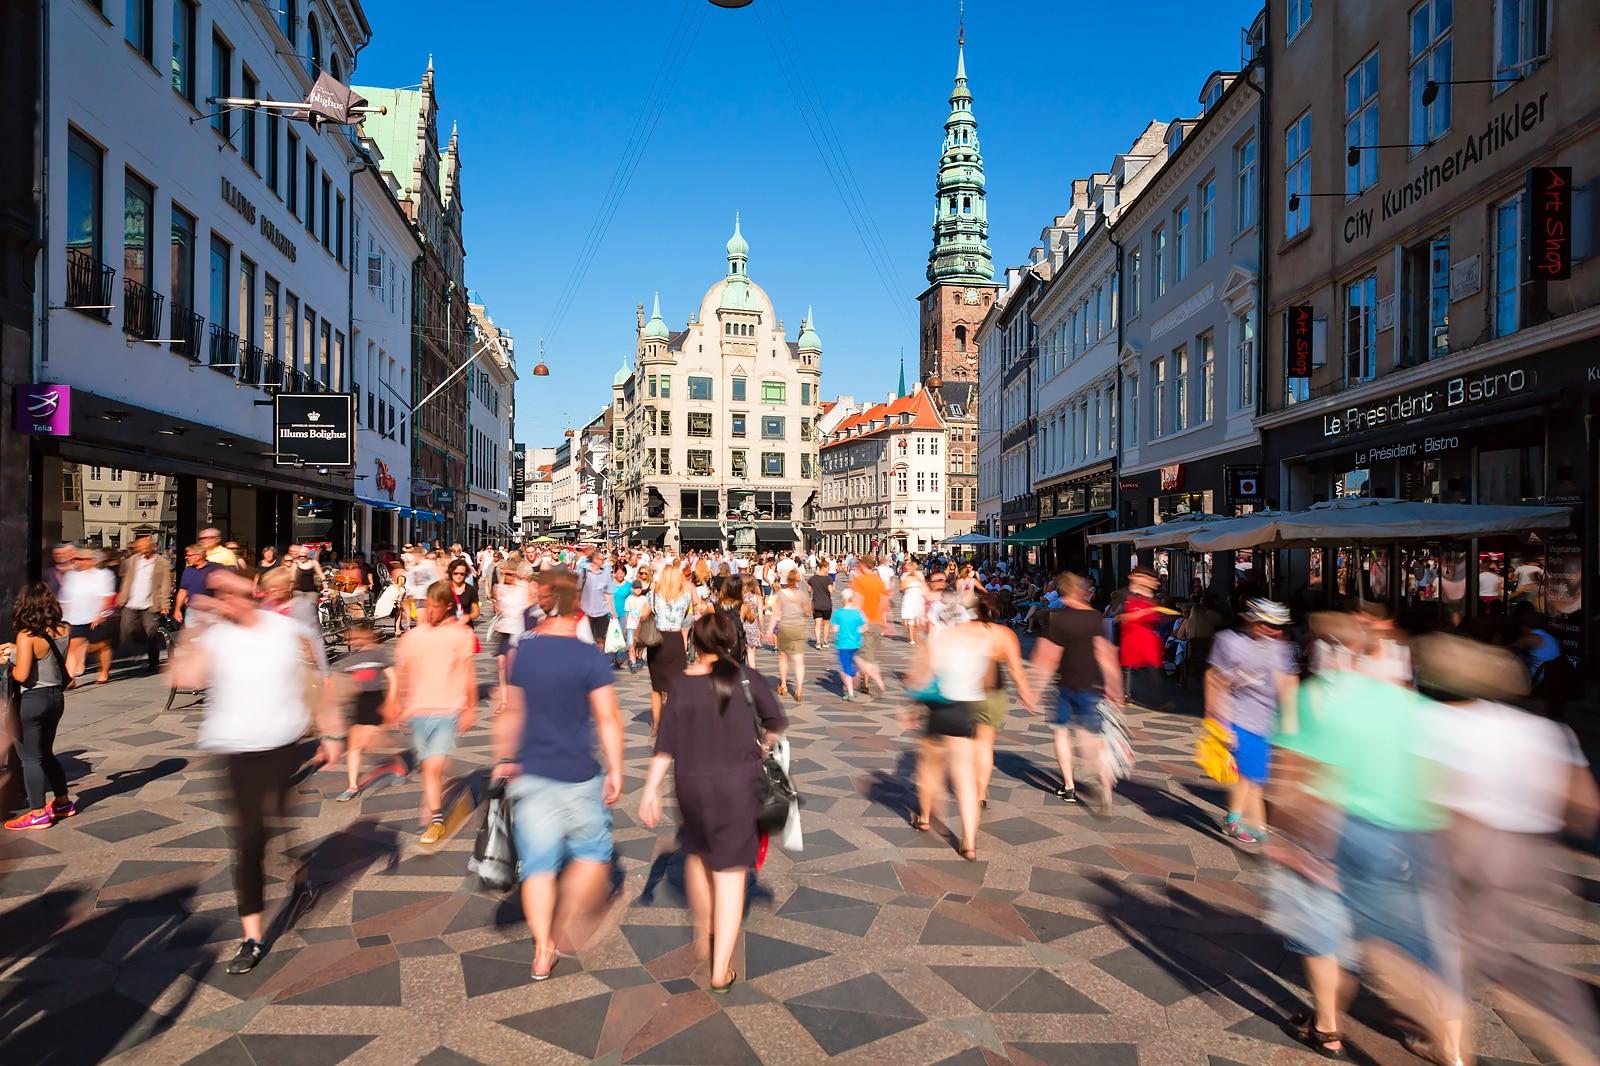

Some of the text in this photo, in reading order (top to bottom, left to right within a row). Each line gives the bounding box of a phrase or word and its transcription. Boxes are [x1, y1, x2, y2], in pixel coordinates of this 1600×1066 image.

[1344, 92, 1548, 243] City KunstnerArtikler
[1546, 170, 1565, 211] Art
[222, 176, 297, 263] ILLUMS BOLIGHUS
[1296, 308, 1308, 335] Art
[280, 429, 347, 440] Illums Bolighus
[1323, 415, 1340, 437] Le
[1355, 435, 1459, 465] Le Président Bistro
[587, 475, 595, 494] HAY
